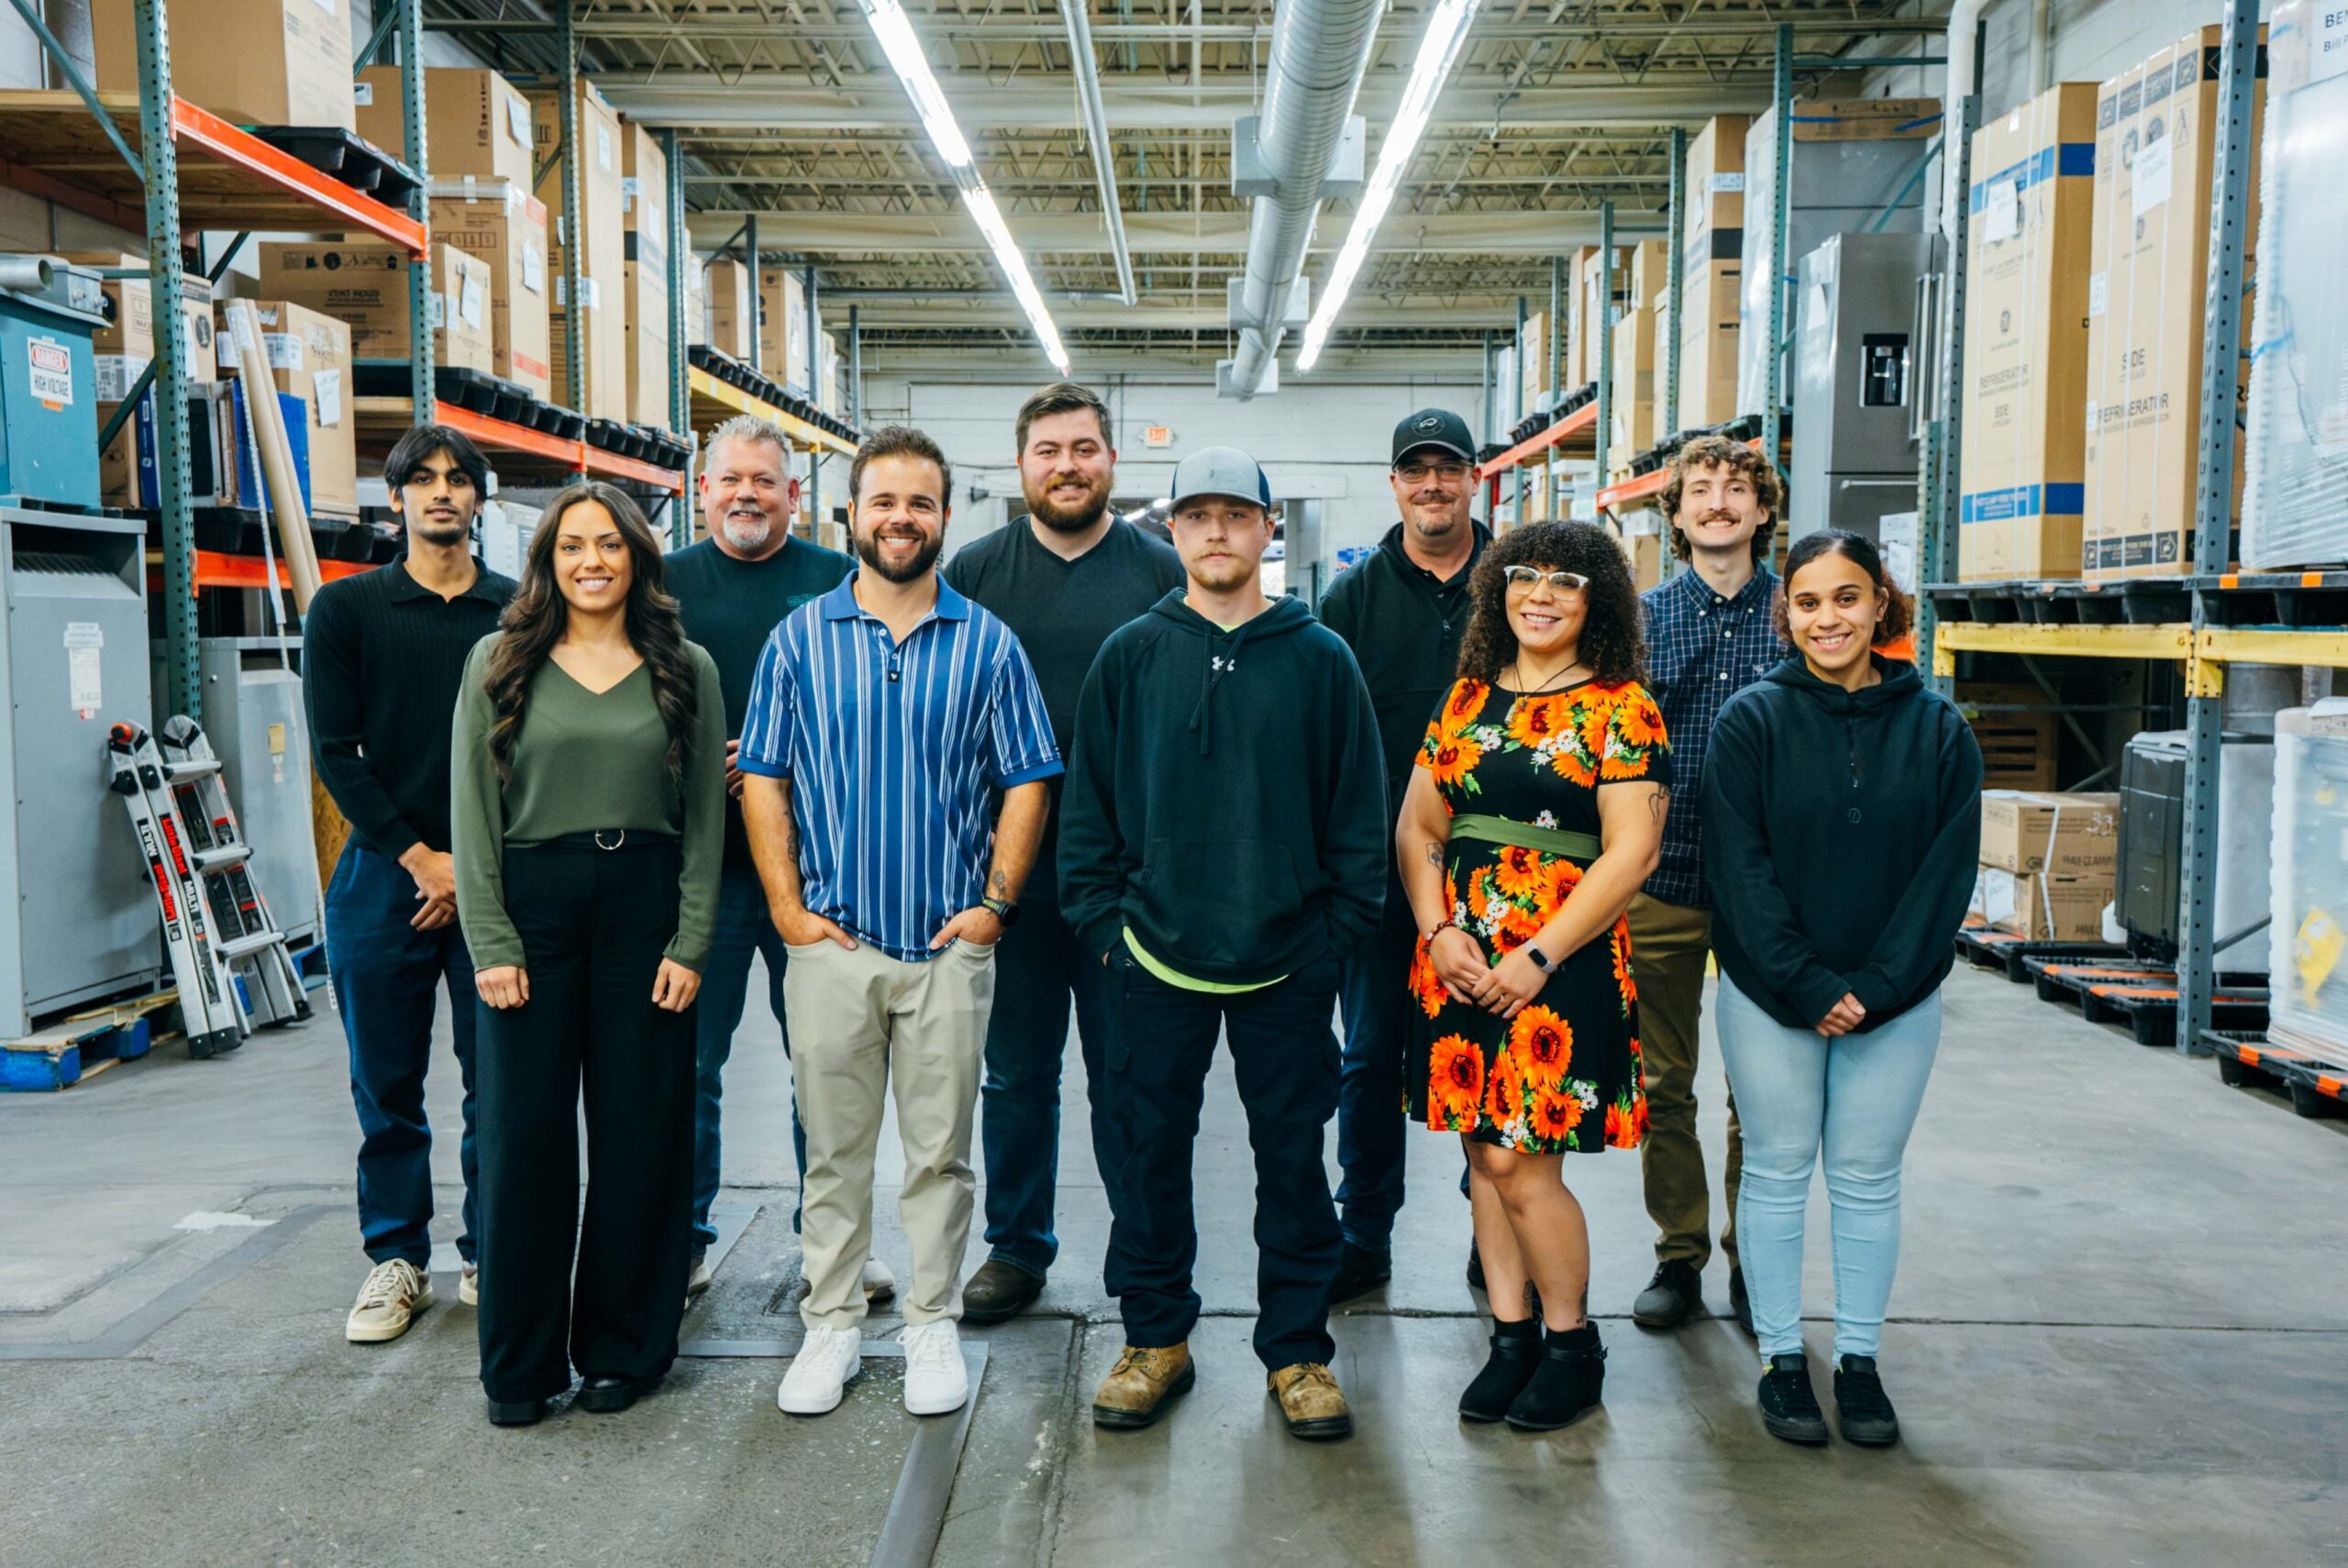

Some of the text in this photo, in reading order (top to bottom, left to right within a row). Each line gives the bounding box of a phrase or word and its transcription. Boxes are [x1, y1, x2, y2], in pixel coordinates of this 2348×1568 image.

[35, 347, 64, 371] DANGER
[2122, 348, 2144, 370] SDE
[34, 373, 69, 397] HIGH VOLTAGE
[139, 823, 159, 858] MULTI
[161, 817, 178, 846] Little
[172, 845, 189, 875] Giant
[183, 879, 200, 913] MULTI
